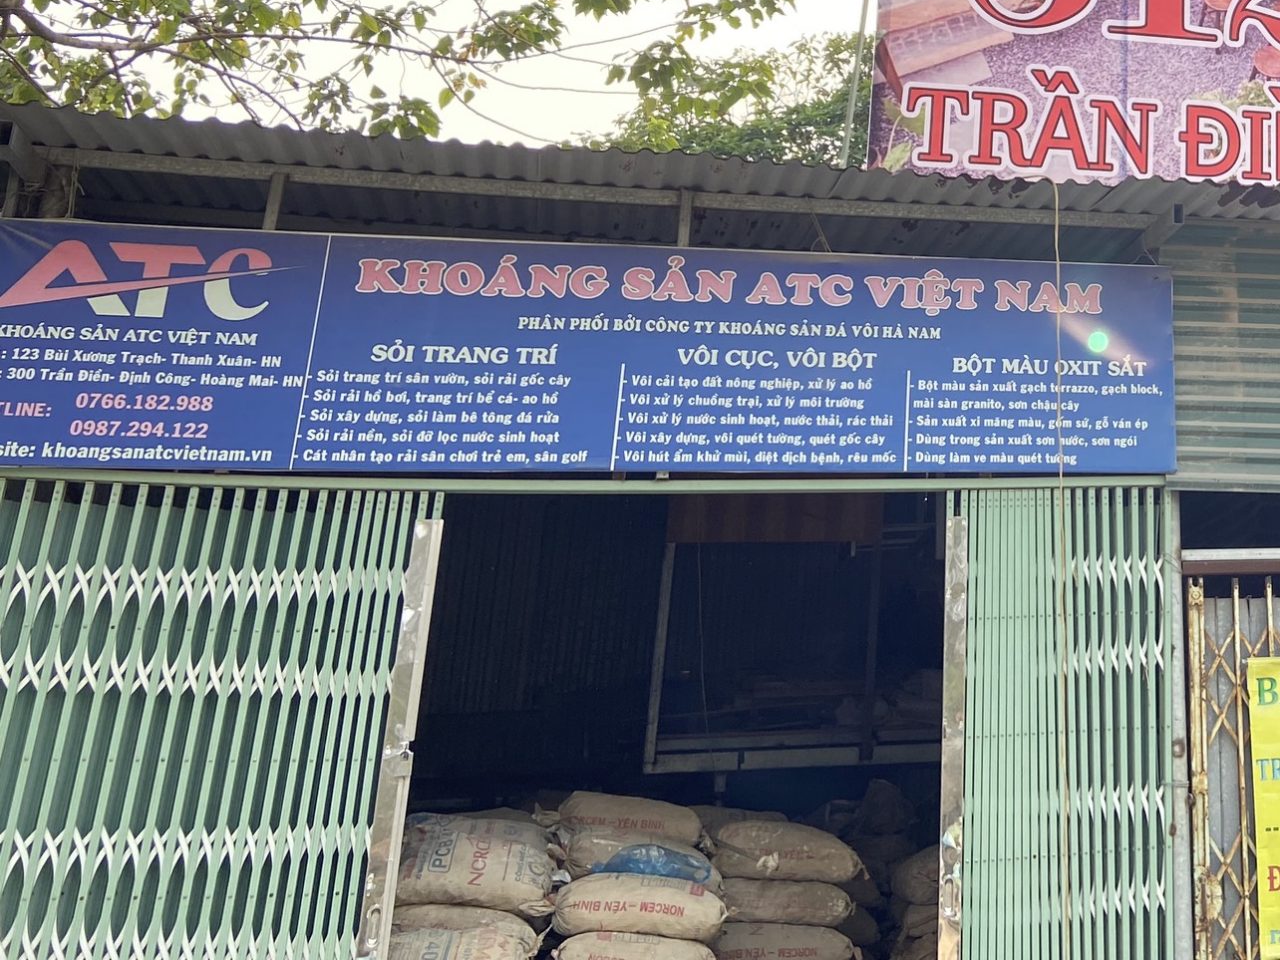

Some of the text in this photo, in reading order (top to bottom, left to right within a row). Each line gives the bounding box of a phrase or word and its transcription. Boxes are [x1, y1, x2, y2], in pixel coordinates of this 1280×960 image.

[902, 64, 1163, 179] TRẦN
[0, 240, 272, 320] ATC
[355, 254, 1102, 316] KHOÁNG SẢN ATC VIỆT NAM
[80, 324, 119, 341] SẢN
[124, 329, 162, 342] ATC
[168, 328, 210, 346] VIỆT
[216, 332, 257, 346] NAM
[517, 312, 941, 340] PHÂN PHỐI BỞI CÔNG TY KHOÁNG SẢN ĐÁ VÔI HÀ NAM
[12, 348, 39, 360] 123
[44, 349, 68, 361] Bùi
[72, 350, 116, 364] Xương
[172, 354, 212, 366] Thanh
[261, 356, 282, 368] HN
[370, 339, 559, 365] SỎI TRANG TRÍ
[678, 344, 877, 372] VÔI CỤC, VÔI BỘT
[952, 353, 1146, 376] BỘT MÀU OXIT SẮT
[317, 369, 339, 383] Sỏi
[343, 372, 380, 385] trang
[385, 371, 401, 383] trí
[405, 372, 429, 384] sân
[474, 373, 493, 385] sỏi
[498, 373, 516, 386] rải
[520, 372, 544, 387] gốc
[549, 374, 571, 387] cây
[76, 393, 213, 412] 0766.182.988
[70, 420, 208, 438] 0987.294.122
[42, 442, 272, 462] khoangsanatcvietnam.vn
